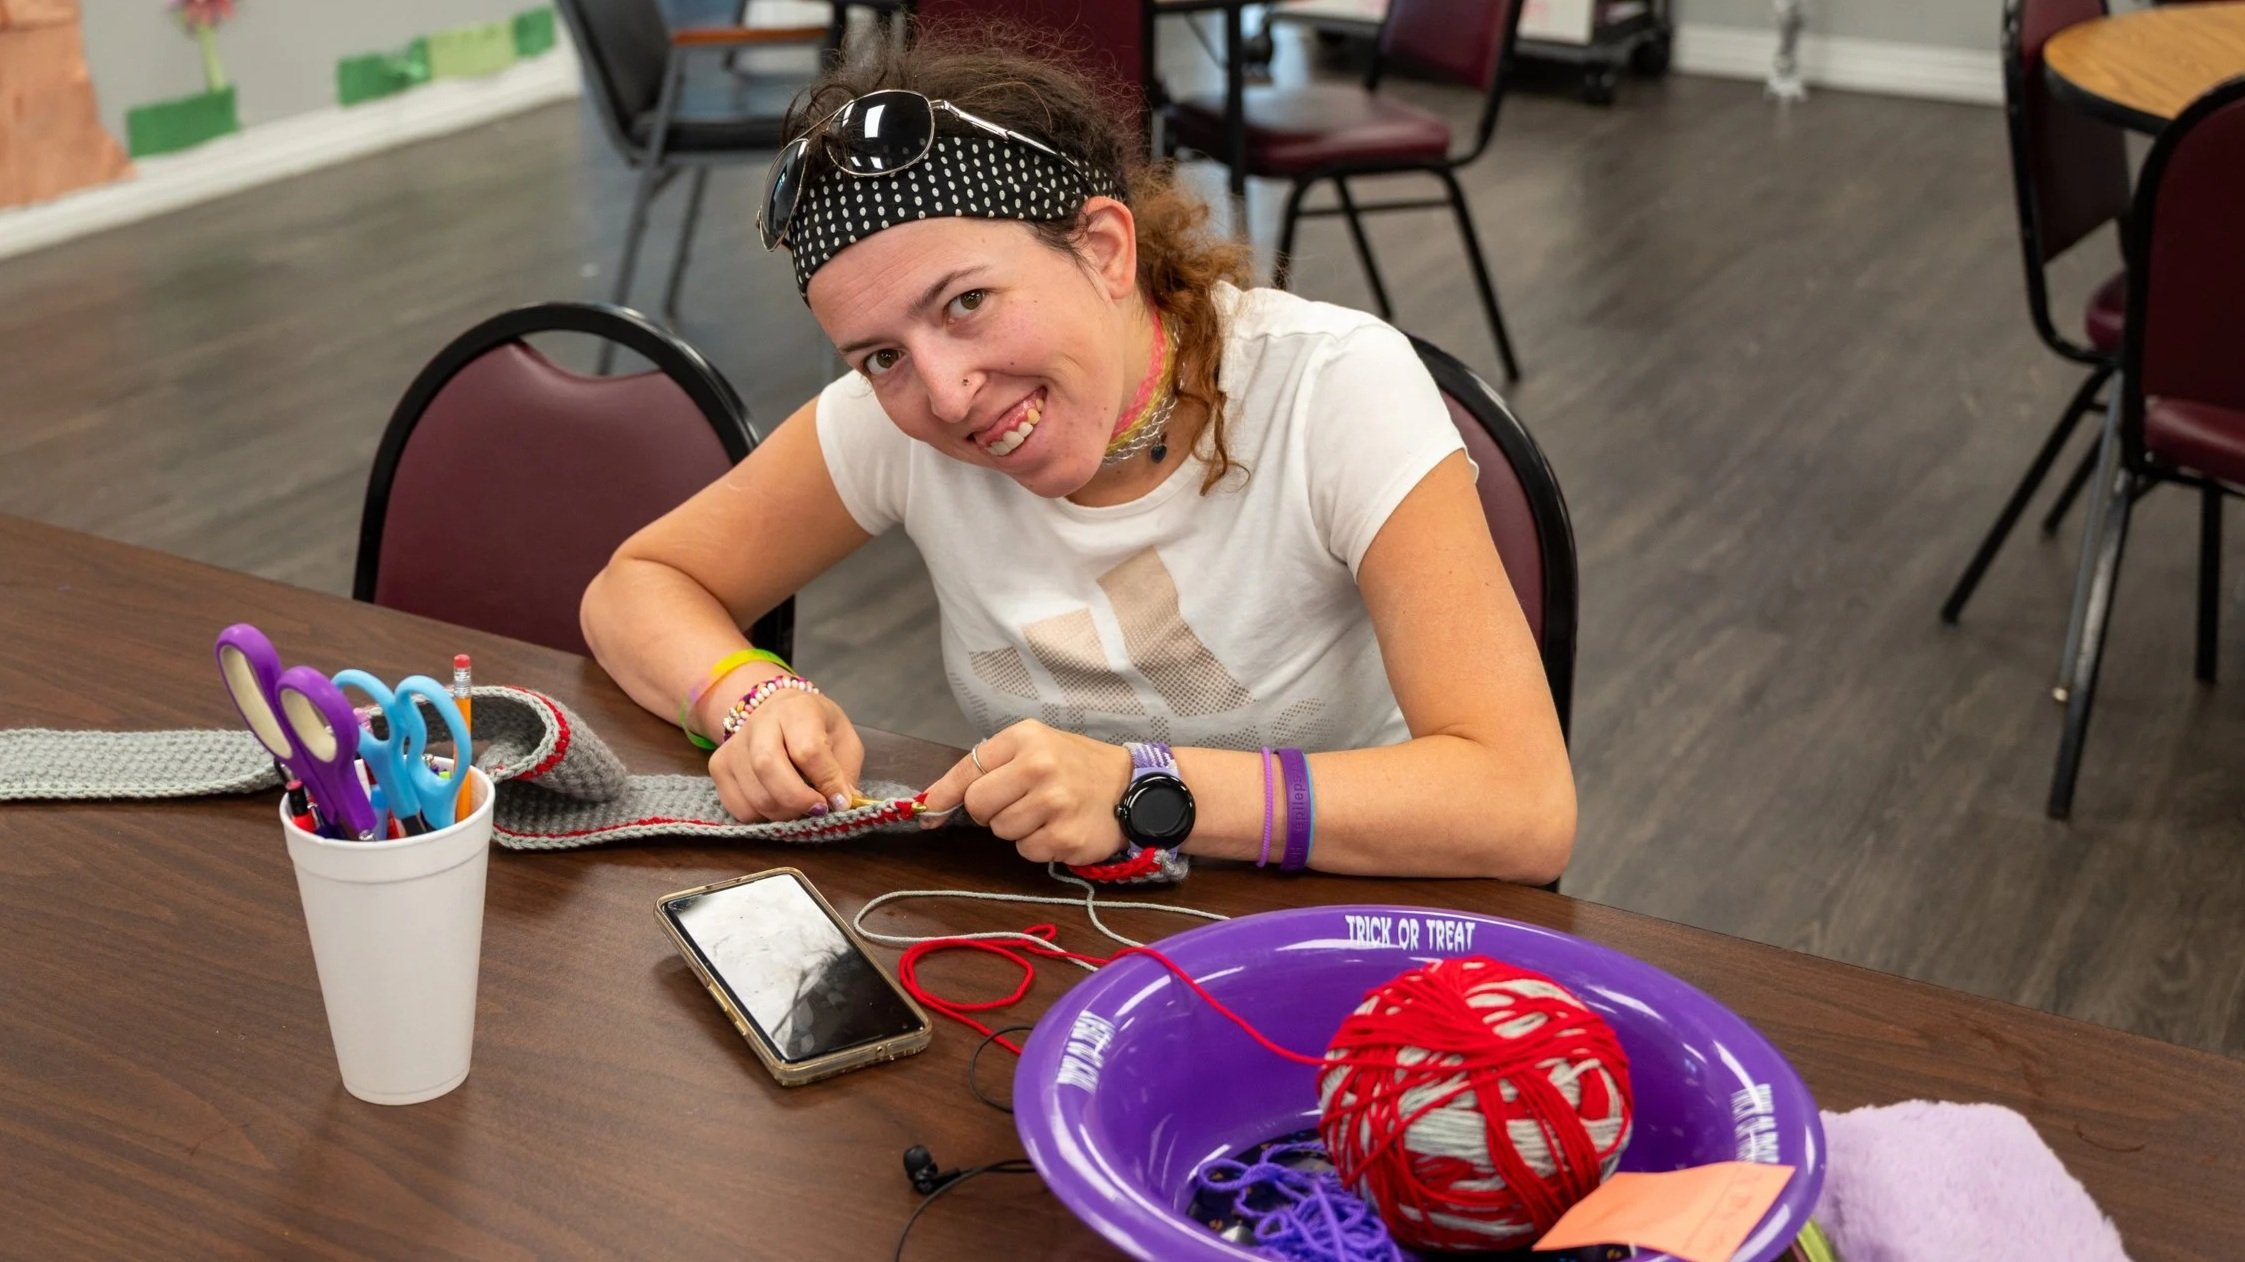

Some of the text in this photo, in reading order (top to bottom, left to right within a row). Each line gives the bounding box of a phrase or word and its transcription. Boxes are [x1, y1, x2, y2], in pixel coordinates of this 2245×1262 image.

[1345, 915, 1476, 952] TRICK OR TREAT
